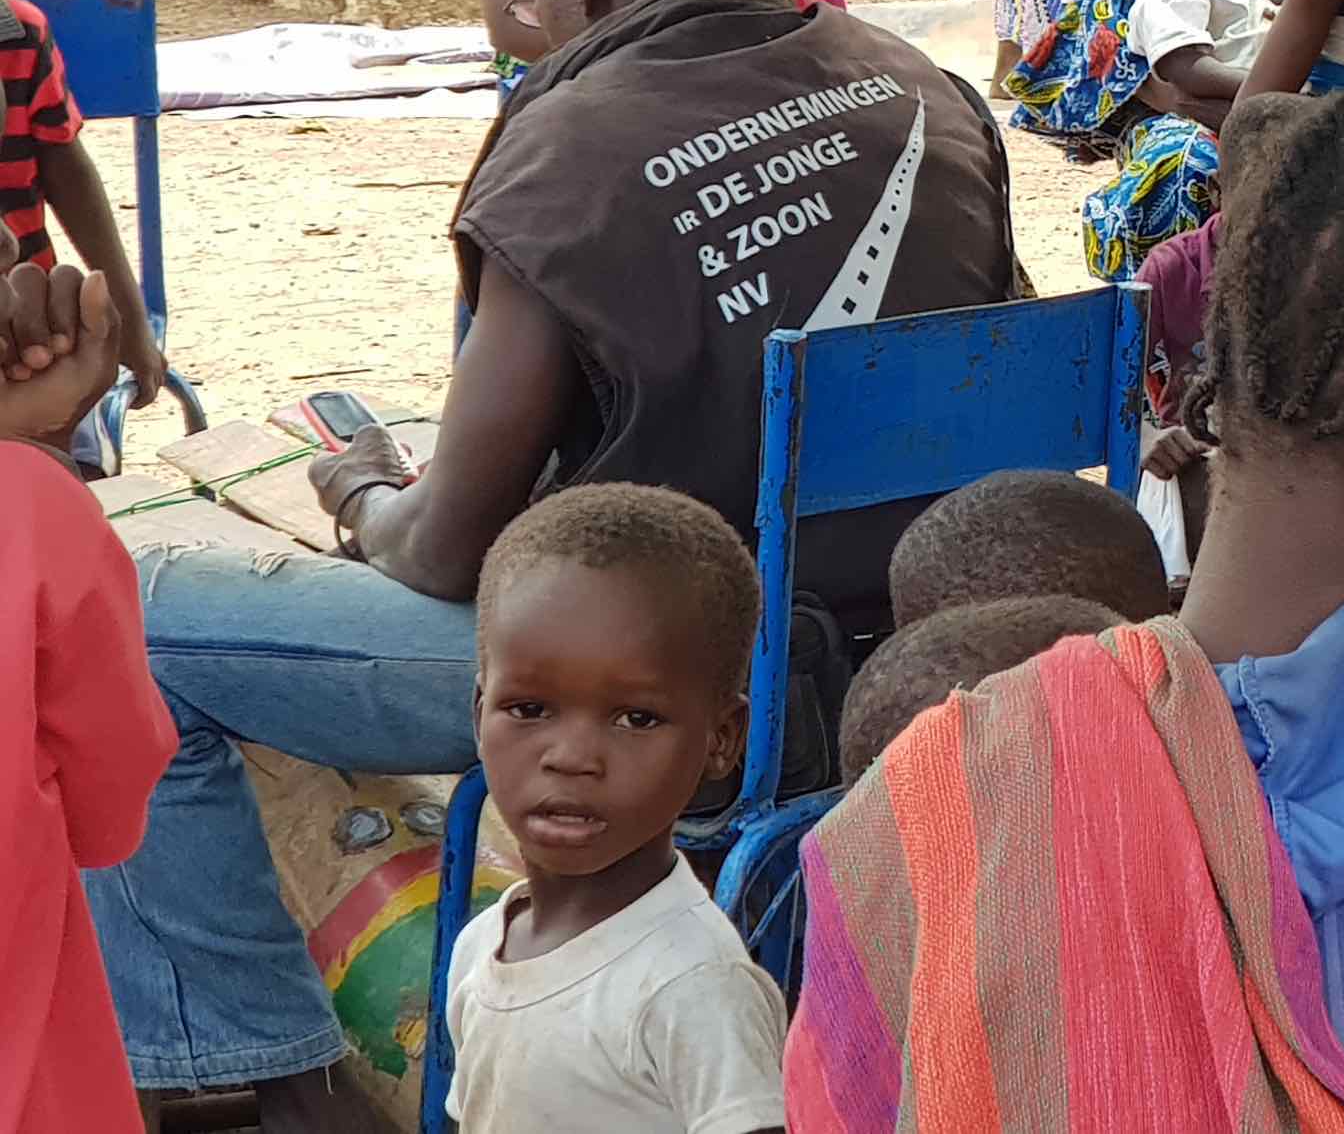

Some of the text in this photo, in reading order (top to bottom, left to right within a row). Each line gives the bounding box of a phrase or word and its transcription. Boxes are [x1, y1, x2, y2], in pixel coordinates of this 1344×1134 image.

[643, 73, 906, 188] ONDERNEMINGEN
[672, 131, 859, 235] IR DE JONGE
[697, 191, 834, 278] & ZOON
[716, 272, 771, 323] NV
